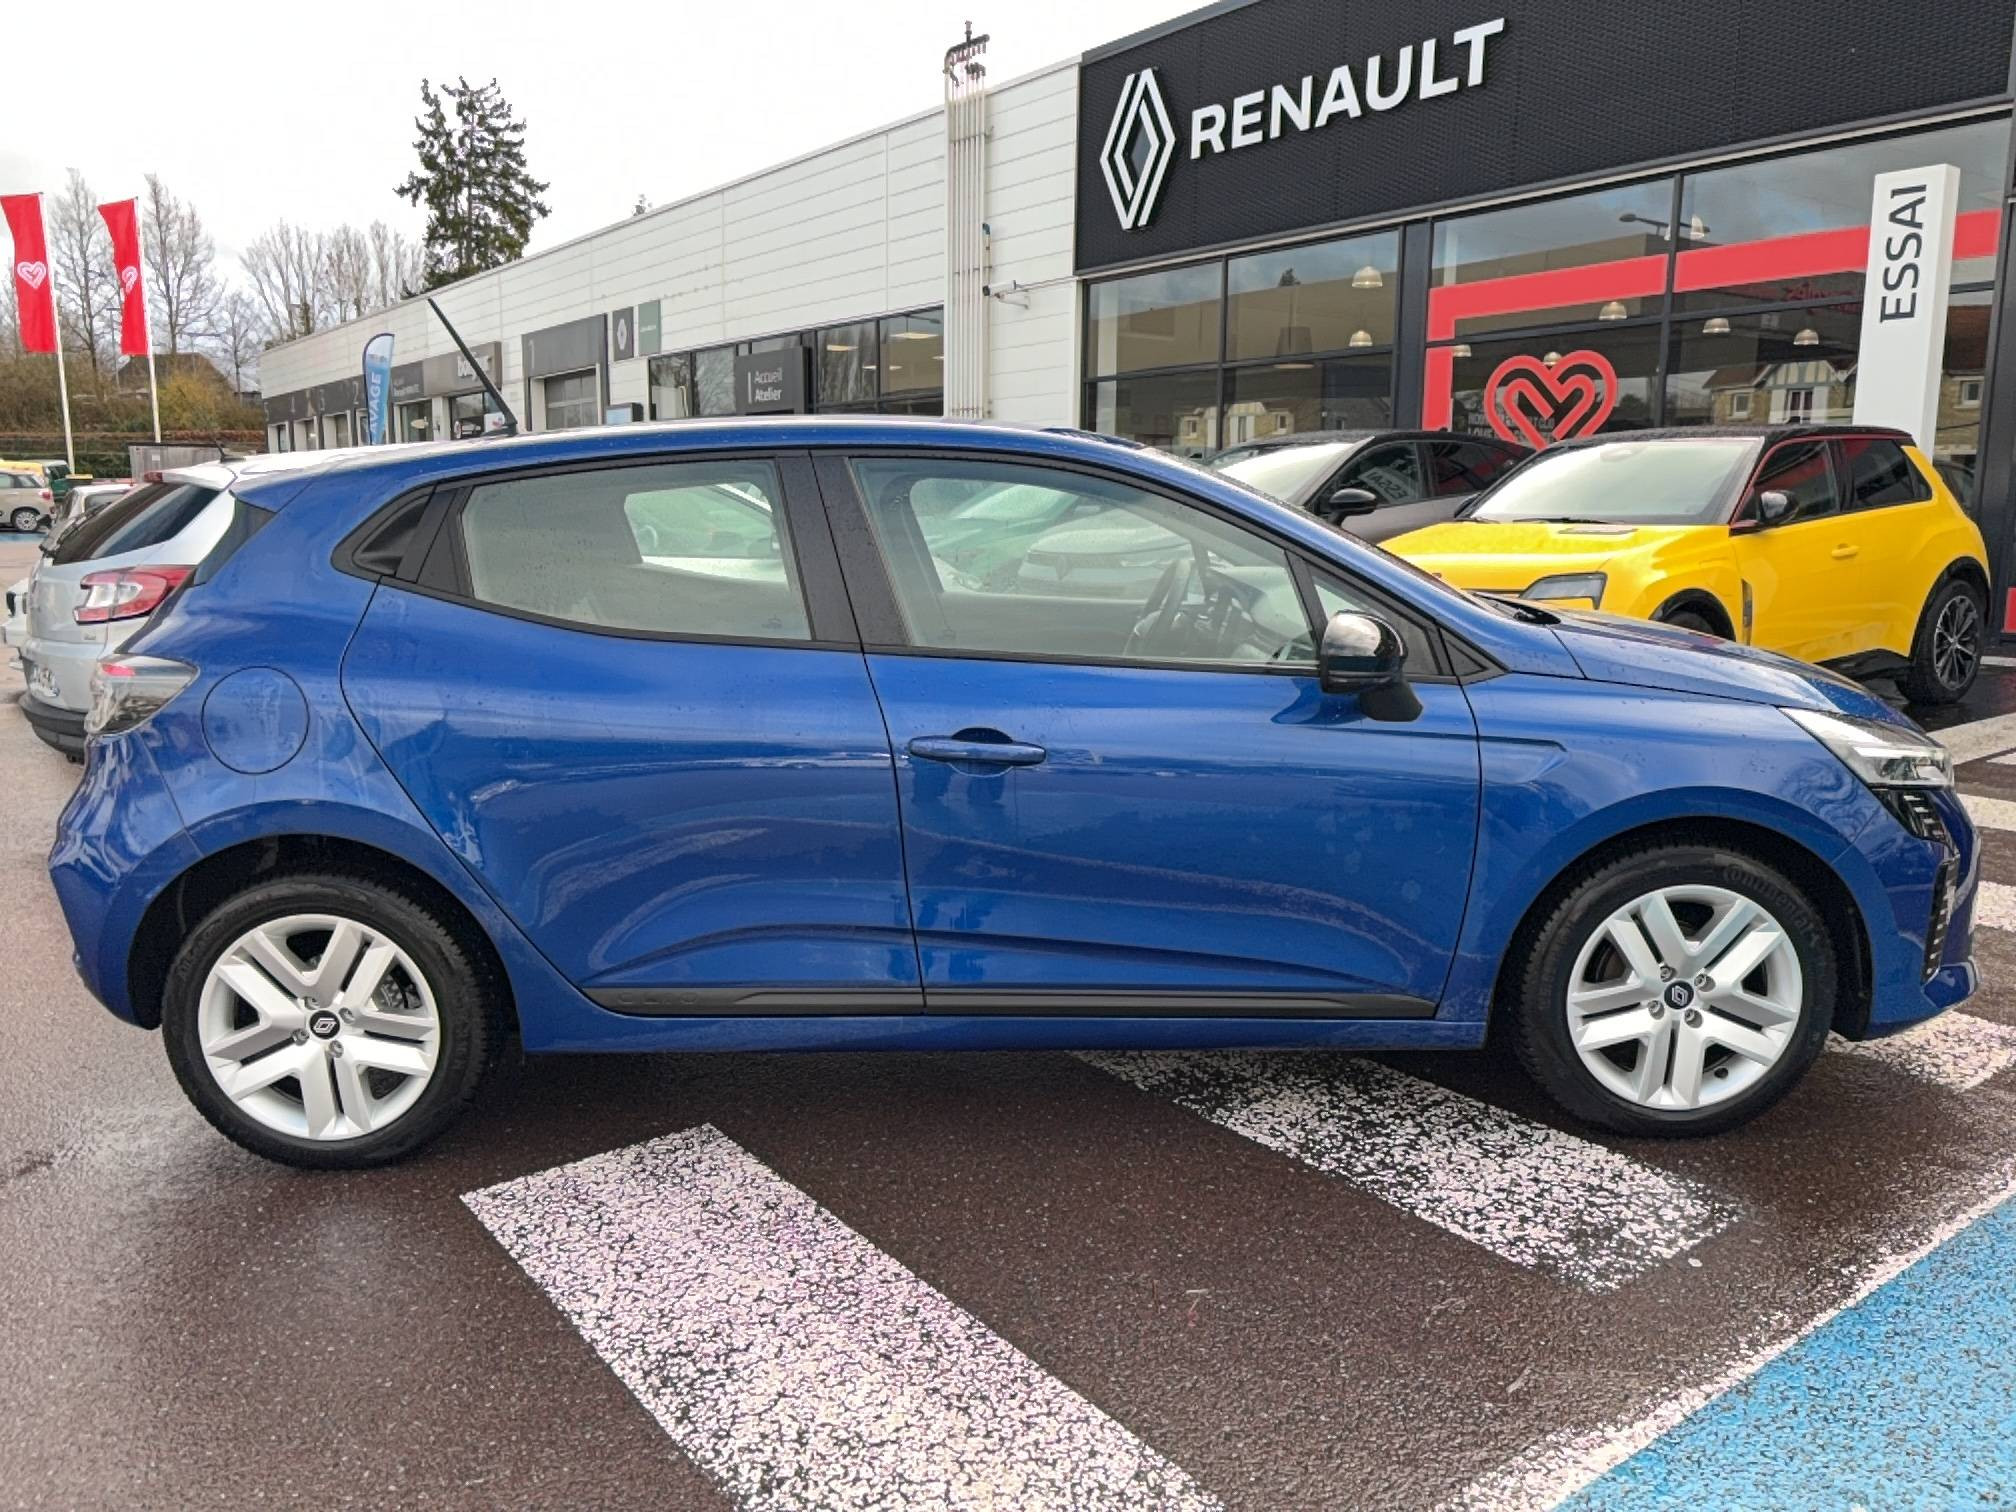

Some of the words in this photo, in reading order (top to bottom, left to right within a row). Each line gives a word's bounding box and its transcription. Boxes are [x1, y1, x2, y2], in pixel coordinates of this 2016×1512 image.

[1190, 17, 1505, 160] RENAULT
[1879, 183, 1928, 323] ESSAI
[369, 371, 383, 443] AVAGE
[754, 368, 782, 384] Accueil
[755, 388, 781, 402] Atelier
[1722, 865, 1815, 936] Continental
